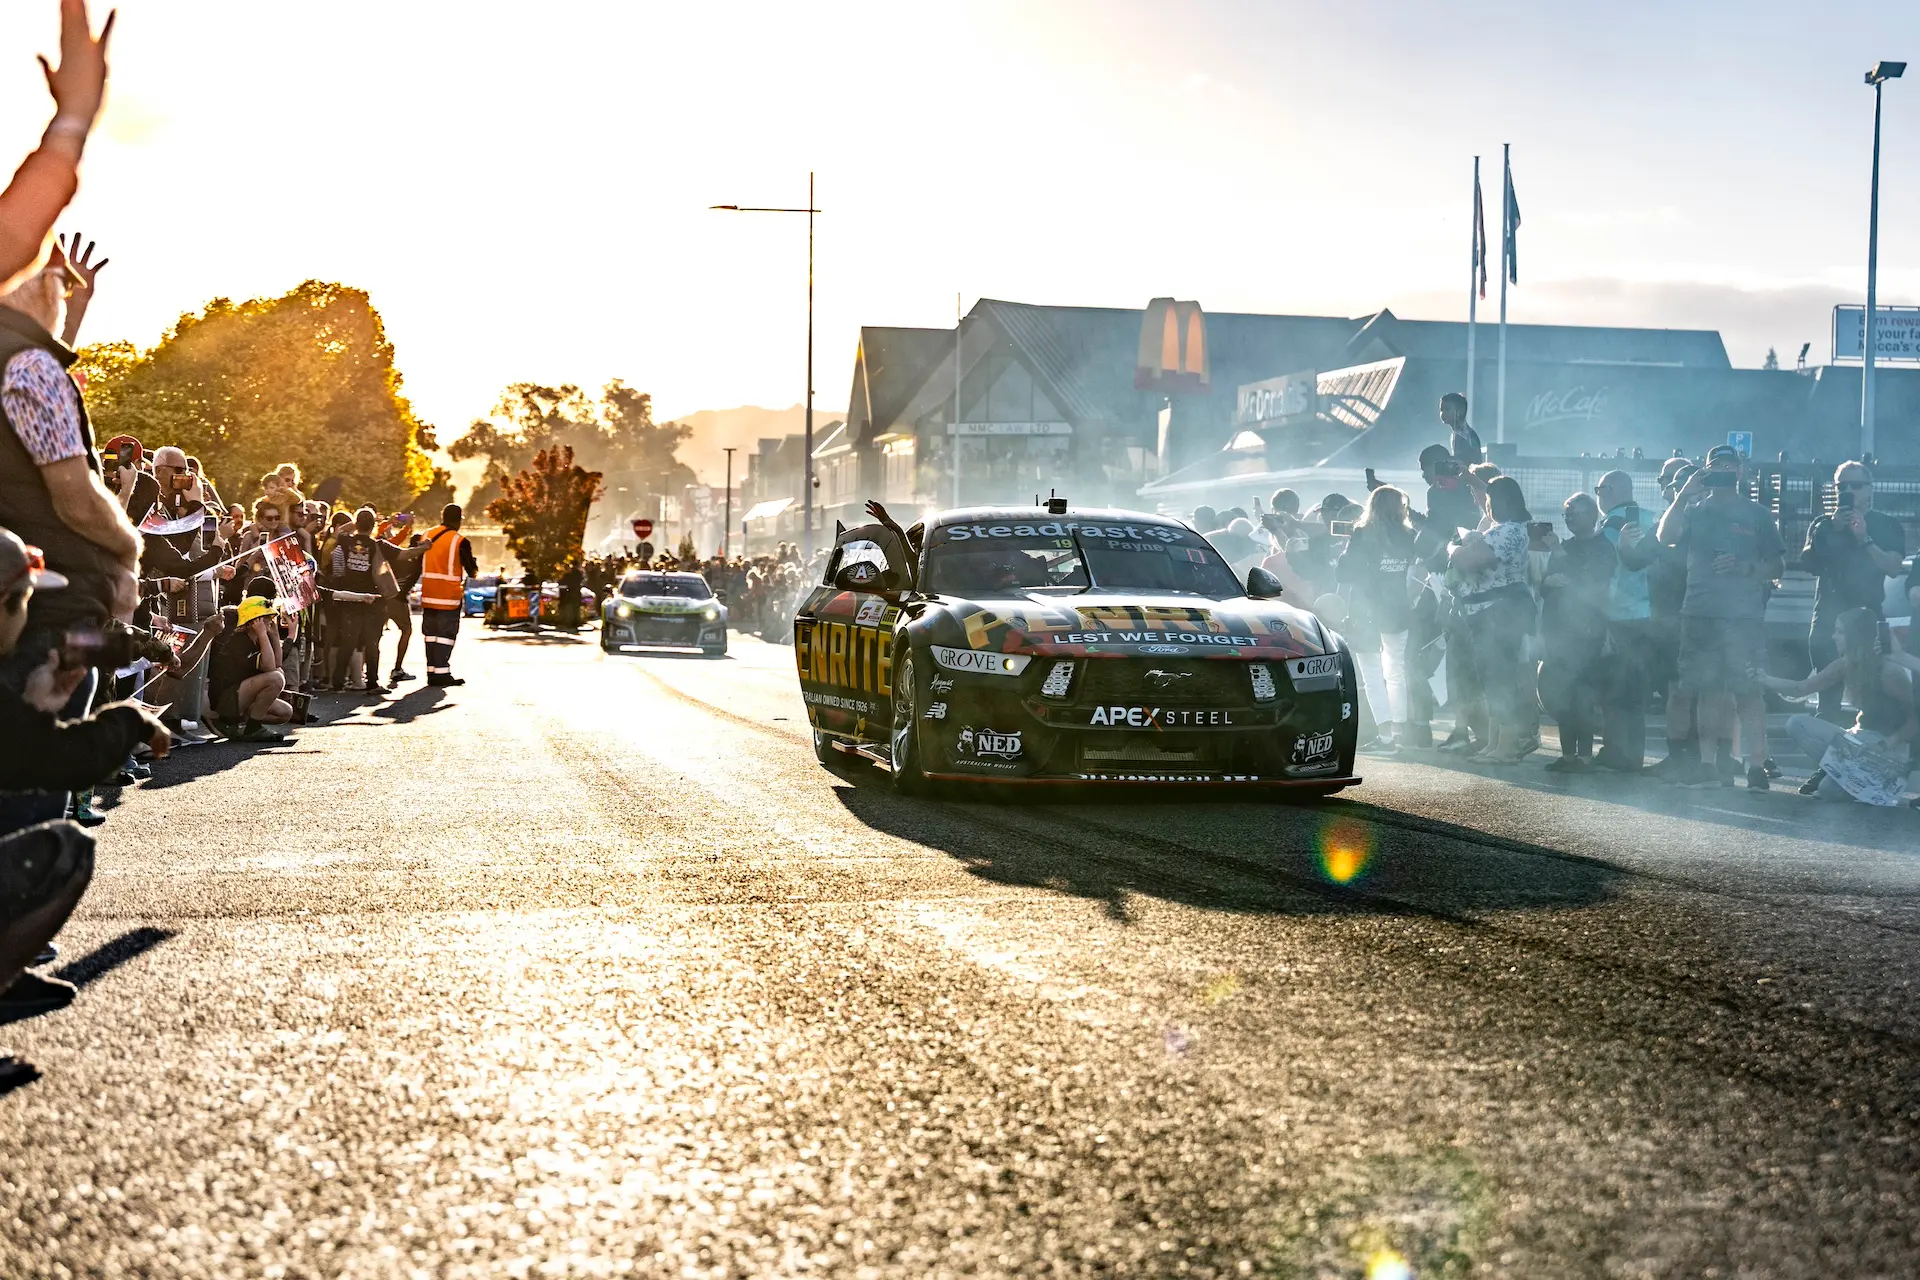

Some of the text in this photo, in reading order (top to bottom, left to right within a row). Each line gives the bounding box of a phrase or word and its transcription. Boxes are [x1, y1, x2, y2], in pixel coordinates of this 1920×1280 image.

[1877, 329, 1906, 341] your
[947, 522, 1143, 541] Steadfast
[1052, 539, 1073, 549] 19
[1108, 540, 1165, 552] Payne
[1054, 632, 1259, 647] LEST WE FORGET
[1147, 645, 1179, 654] Ford
[940, 648, 996, 671] GROVE
[823, 695, 840, 707] OWNED
[840, 697, 855, 710] SINCE
[1089, 705, 1233, 729] APEX STEEL
[978, 734, 1021, 753] NED
[1306, 735, 1333, 757] NED
[955, 759, 991, 768] AUSTRALIAN
